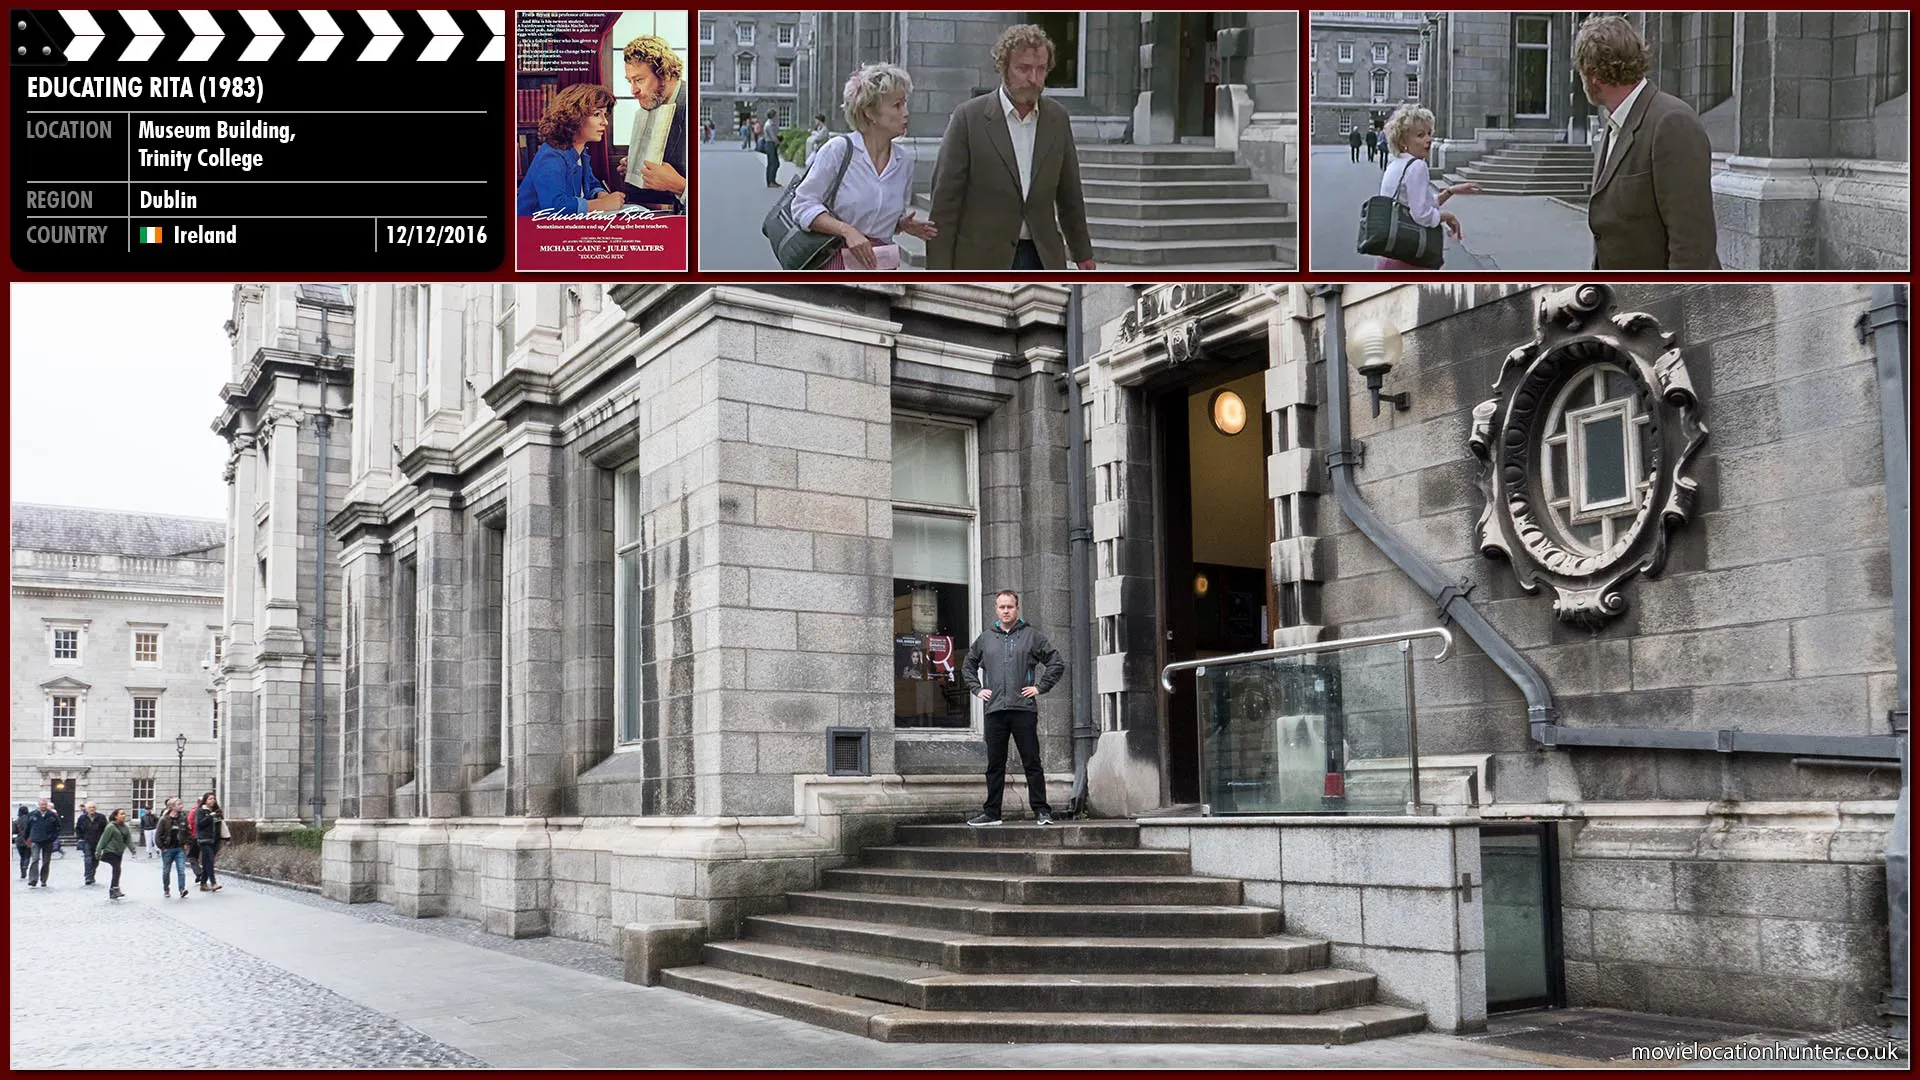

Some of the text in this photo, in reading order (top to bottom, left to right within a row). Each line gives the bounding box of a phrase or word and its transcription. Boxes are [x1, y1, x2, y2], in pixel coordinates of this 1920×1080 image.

[531, 207, 665, 231] Educating Rita
[606, 245, 629, 253] JULIE
